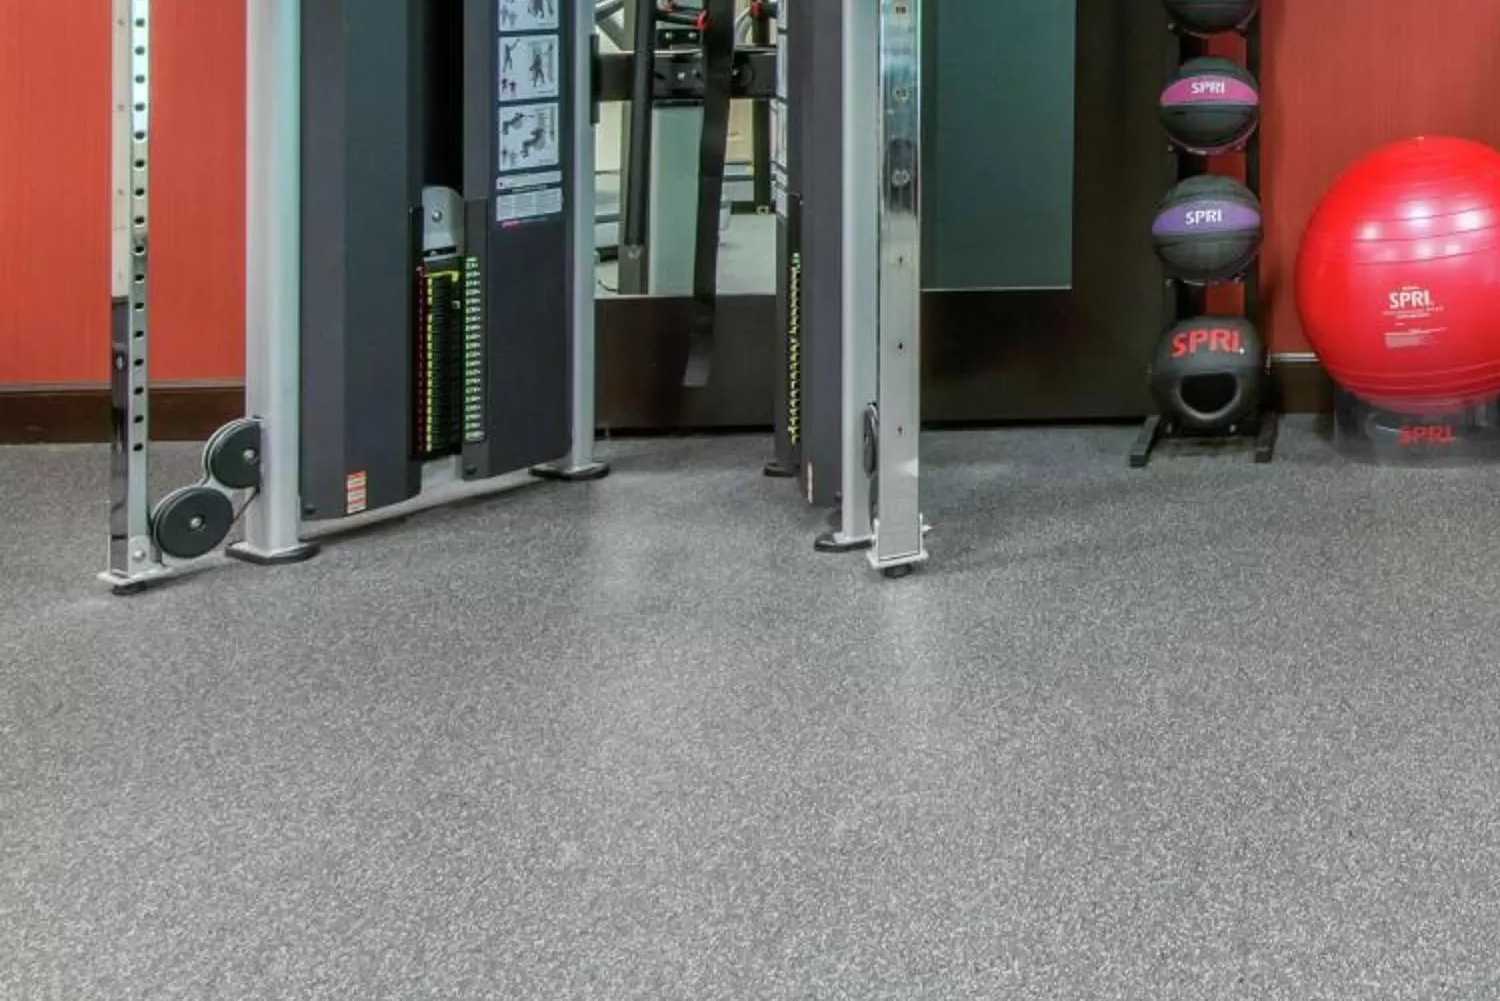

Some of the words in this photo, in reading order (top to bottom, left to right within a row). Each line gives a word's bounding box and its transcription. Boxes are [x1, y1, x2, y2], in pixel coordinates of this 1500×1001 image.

[1191, 82, 1225, 95] SPRI
[1185, 208, 1222, 225] SPRI
[1389, 289, 1430, 310] SPRI
